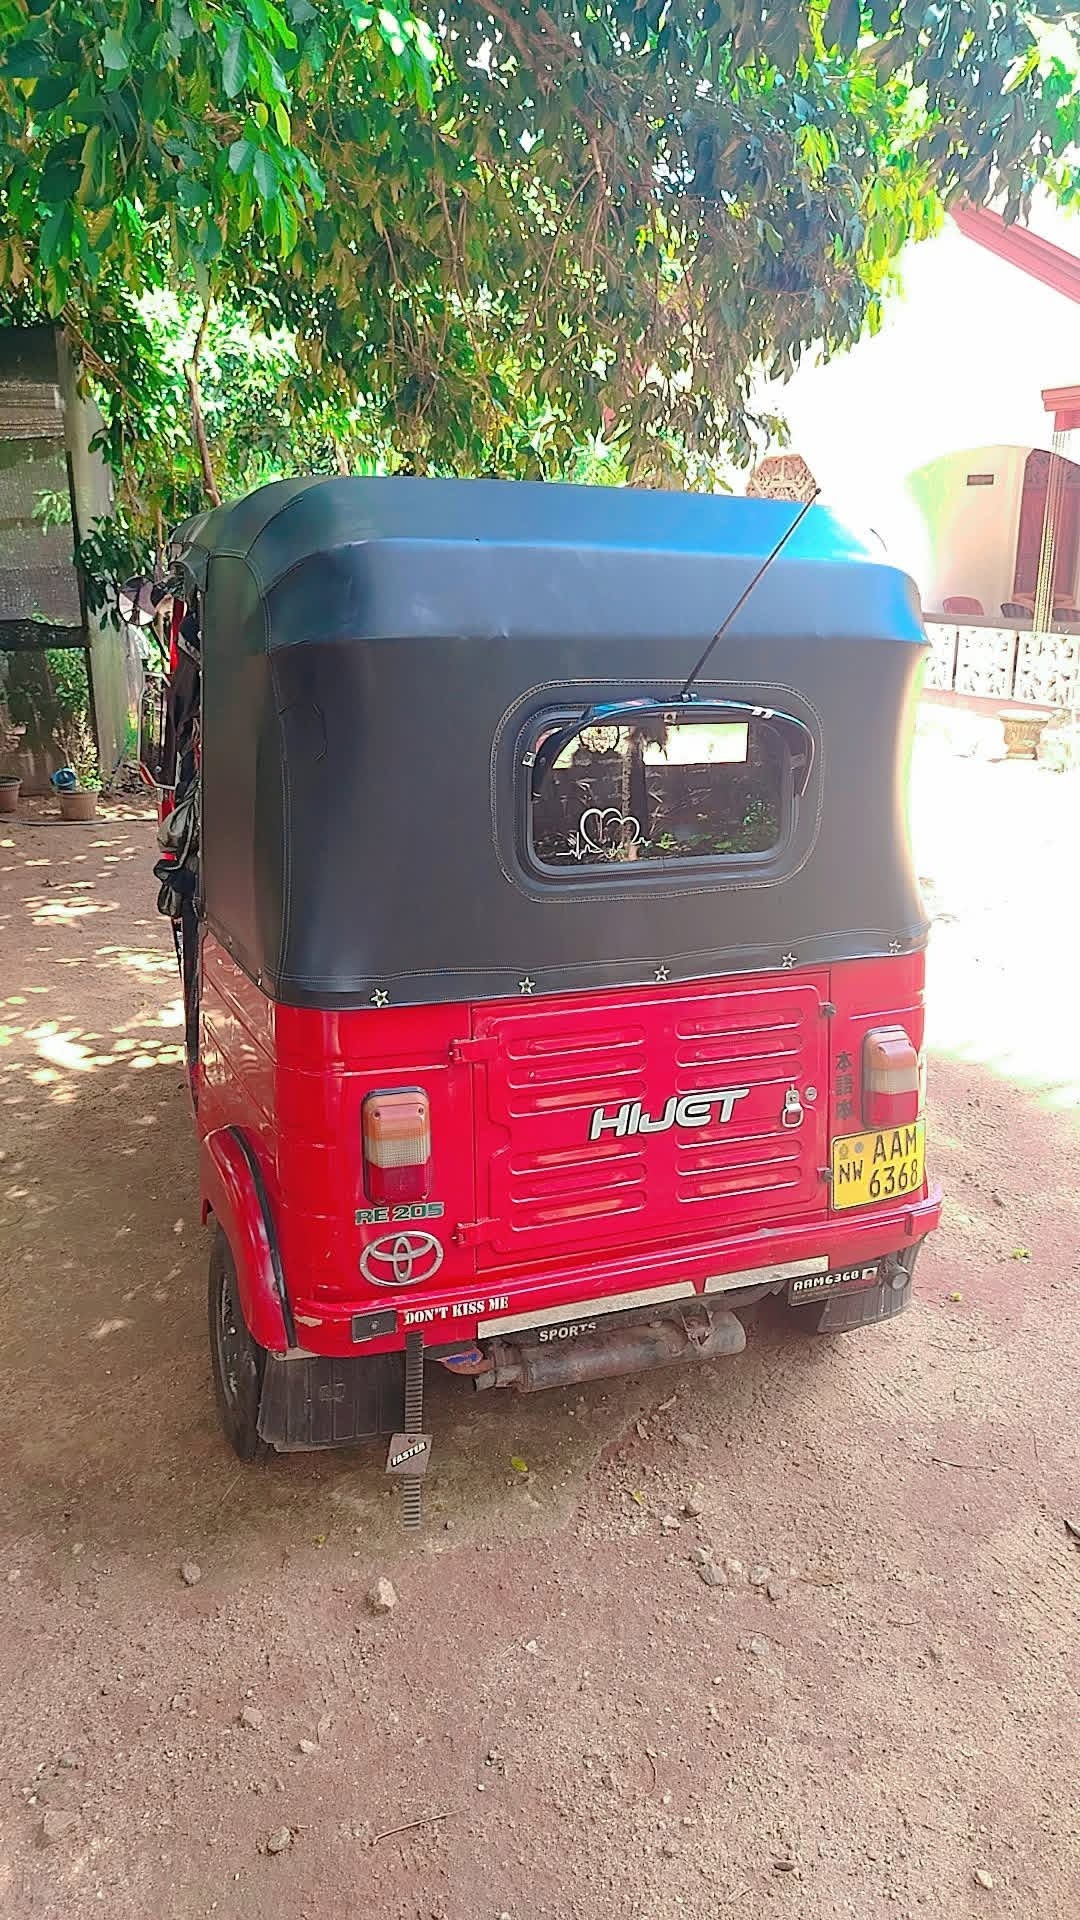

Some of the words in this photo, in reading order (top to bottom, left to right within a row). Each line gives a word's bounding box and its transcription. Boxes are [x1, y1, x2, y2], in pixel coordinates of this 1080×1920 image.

[588, 1088, 750, 1141] HIJET
[872, 1126, 917, 1165] AAM
[838, 1159, 864, 1185] NW
[868, 1158, 918, 1198] 6368
[355, 1206, 388, 1225] RE
[393, 1202, 445, 1223] 205
[404, 1306, 449, 1325] DON'T
[452, 1300, 485, 1318] KISS
[489, 1296, 509, 1311] ME
[539, 1321, 597, 1342] SPORTS
